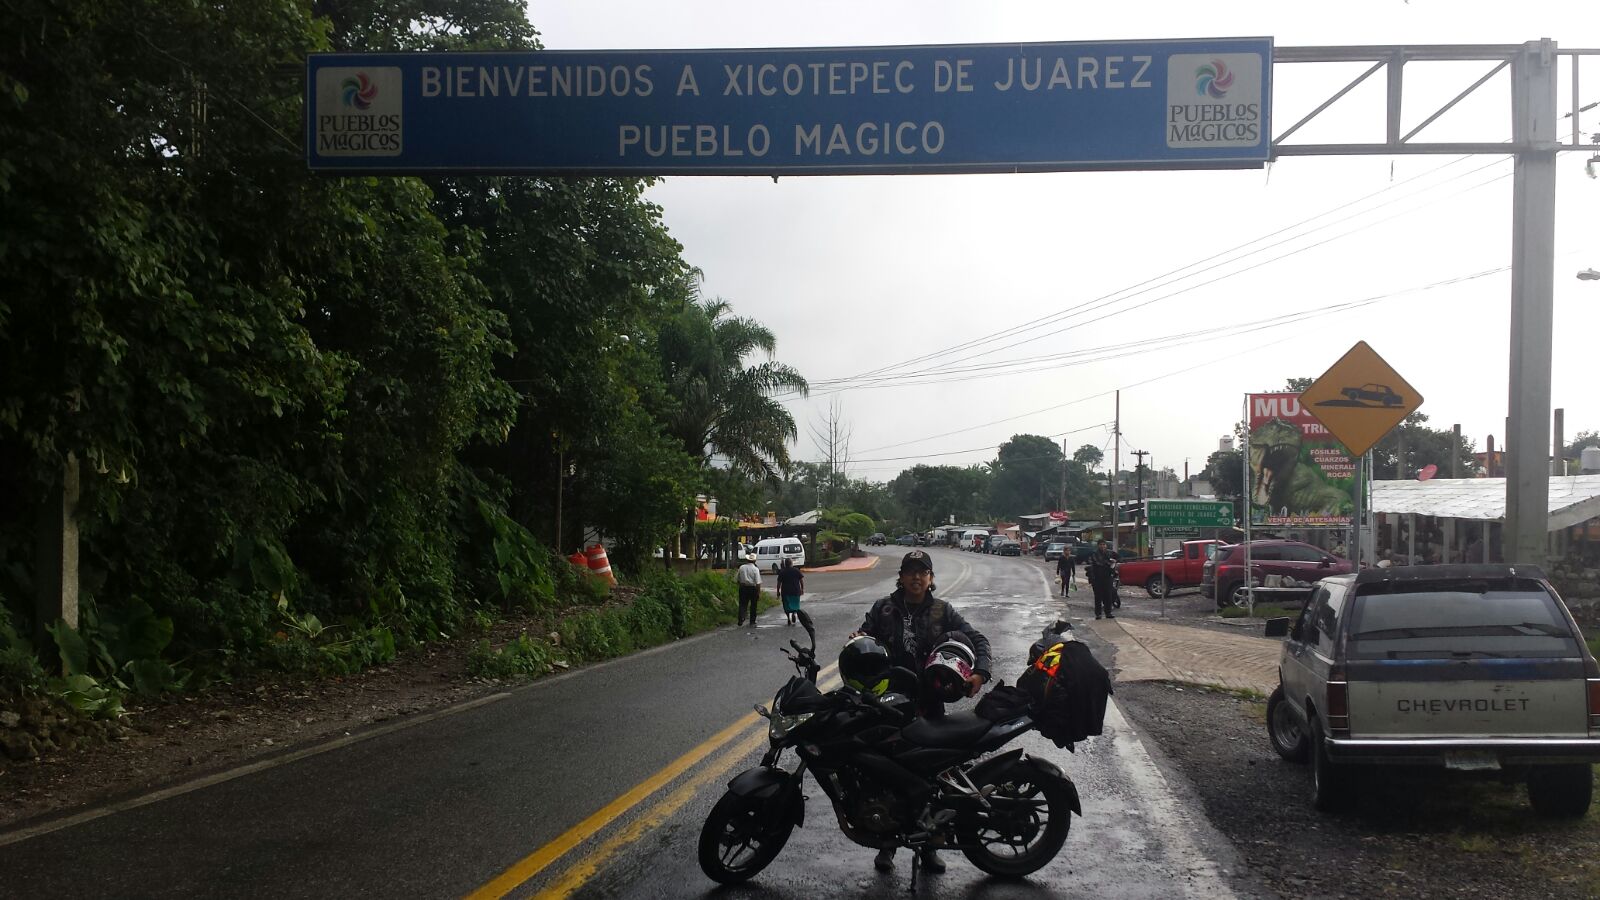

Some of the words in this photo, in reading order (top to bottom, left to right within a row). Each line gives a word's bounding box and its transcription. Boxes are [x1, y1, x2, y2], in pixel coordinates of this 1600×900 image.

[422, 64, 654, 97] BIENVENIDOS
[676, 65, 700, 96] A
[723, 60, 915, 96] XICOTEPEC
[934, 59, 974, 92] DE
[994, 55, 1153, 91] JUAREZ
[619, 124, 770, 157] PUEBLO
[795, 121, 945, 155] MAGICO
[1255, 398, 1312, 417] MU
[1397, 698, 1529, 712] CHEVROLET
